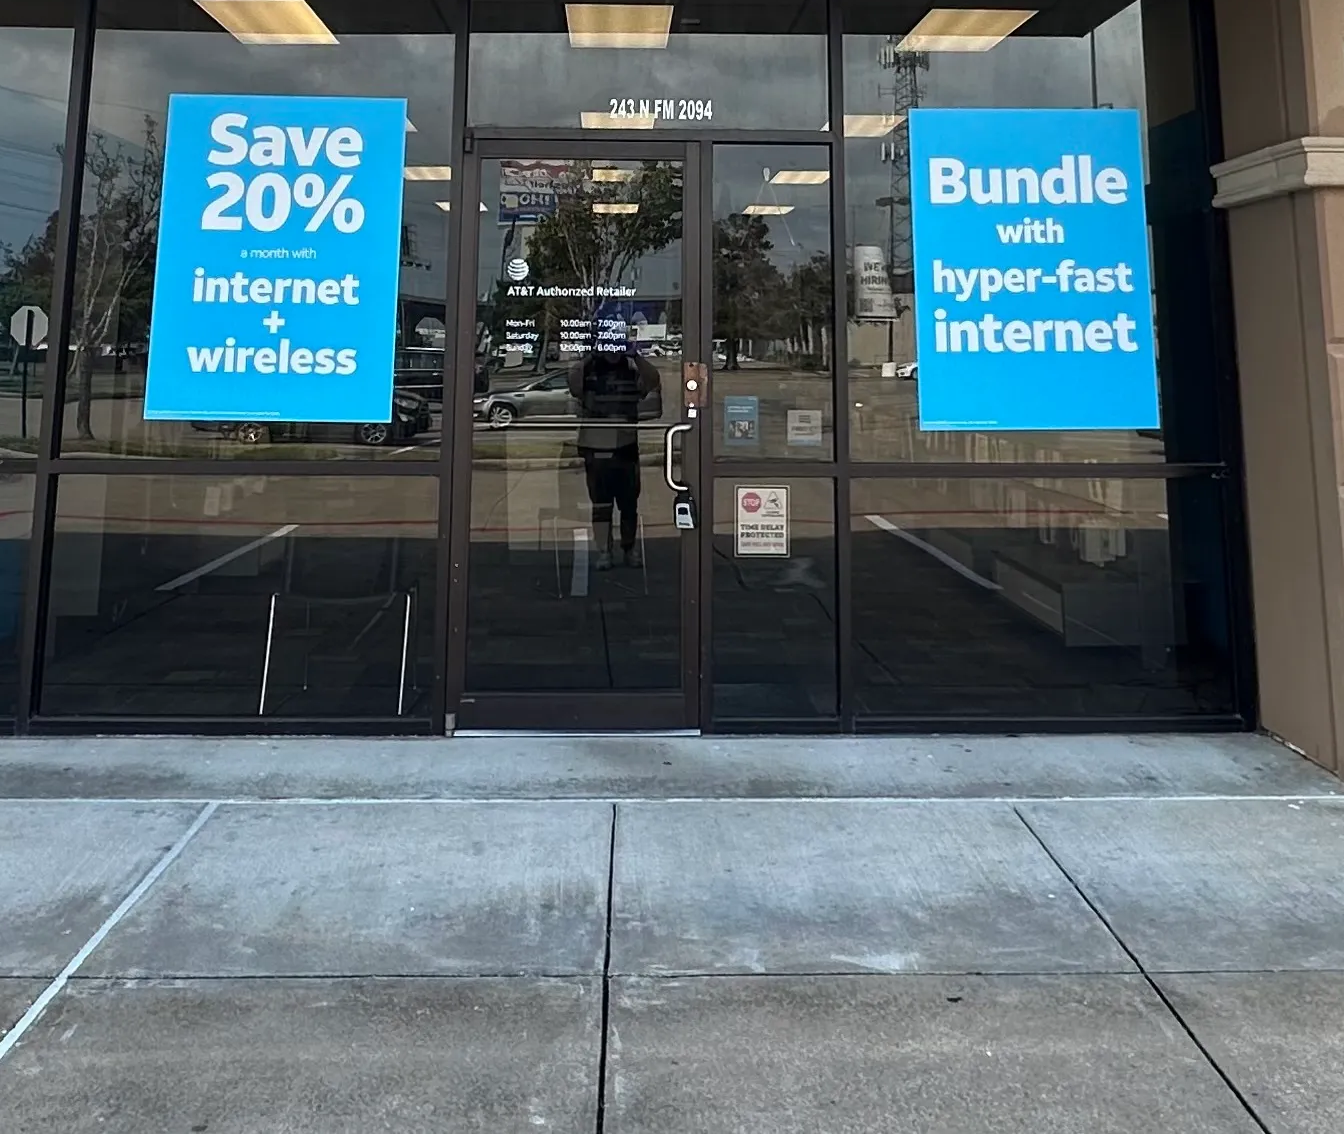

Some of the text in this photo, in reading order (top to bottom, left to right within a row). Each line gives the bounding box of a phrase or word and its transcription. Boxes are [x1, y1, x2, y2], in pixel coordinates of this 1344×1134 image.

[609, 98, 713, 121] 243 N FM 2094
[207, 112, 364, 168] Save
[928, 154, 1128, 205] Bundle
[200, 171, 366, 234] 20%
[996, 217, 1065, 244] with
[239, 247, 317, 259] a month with
[192, 266, 360, 306] internet
[506, 286, 535, 297] AT&T
[596, 285, 637, 297] Retailer
[932, 259, 1135, 302] hyper-fast
[262, 310, 286, 334] +
[933, 307, 1139, 354] internet
[186, 336, 358, 375] wireless
